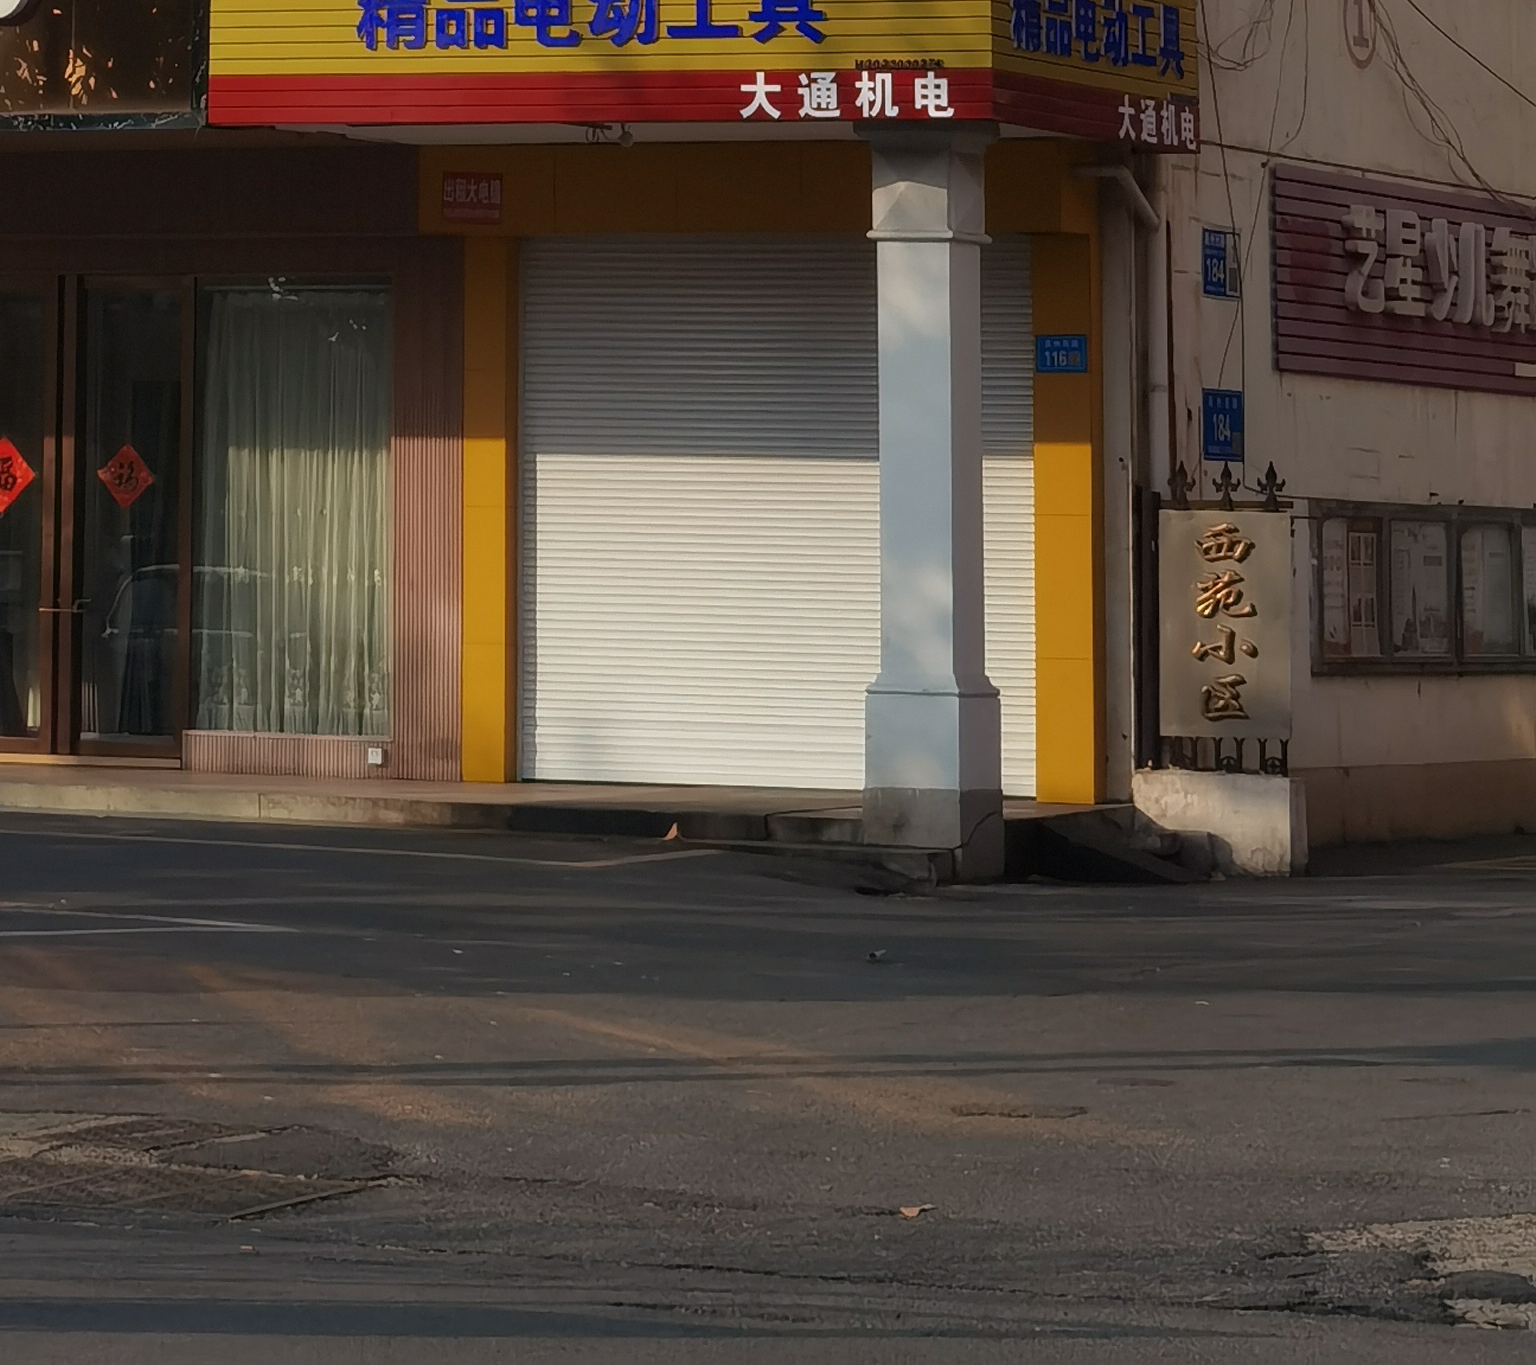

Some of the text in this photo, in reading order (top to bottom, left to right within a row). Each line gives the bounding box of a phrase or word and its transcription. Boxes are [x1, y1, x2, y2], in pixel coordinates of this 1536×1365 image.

[739, 71, 955, 122] 大通机电
[1118, 94, 1197, 151] 大通机电
[1206, 258, 1225, 283] 184
[1342, 204, 1536, 335] 艺星少儿舞
[1045, 350, 1068, 366] 116
[1212, 413, 1231, 442] 184
[1192, 522, 1260, 722] 西苑小区
